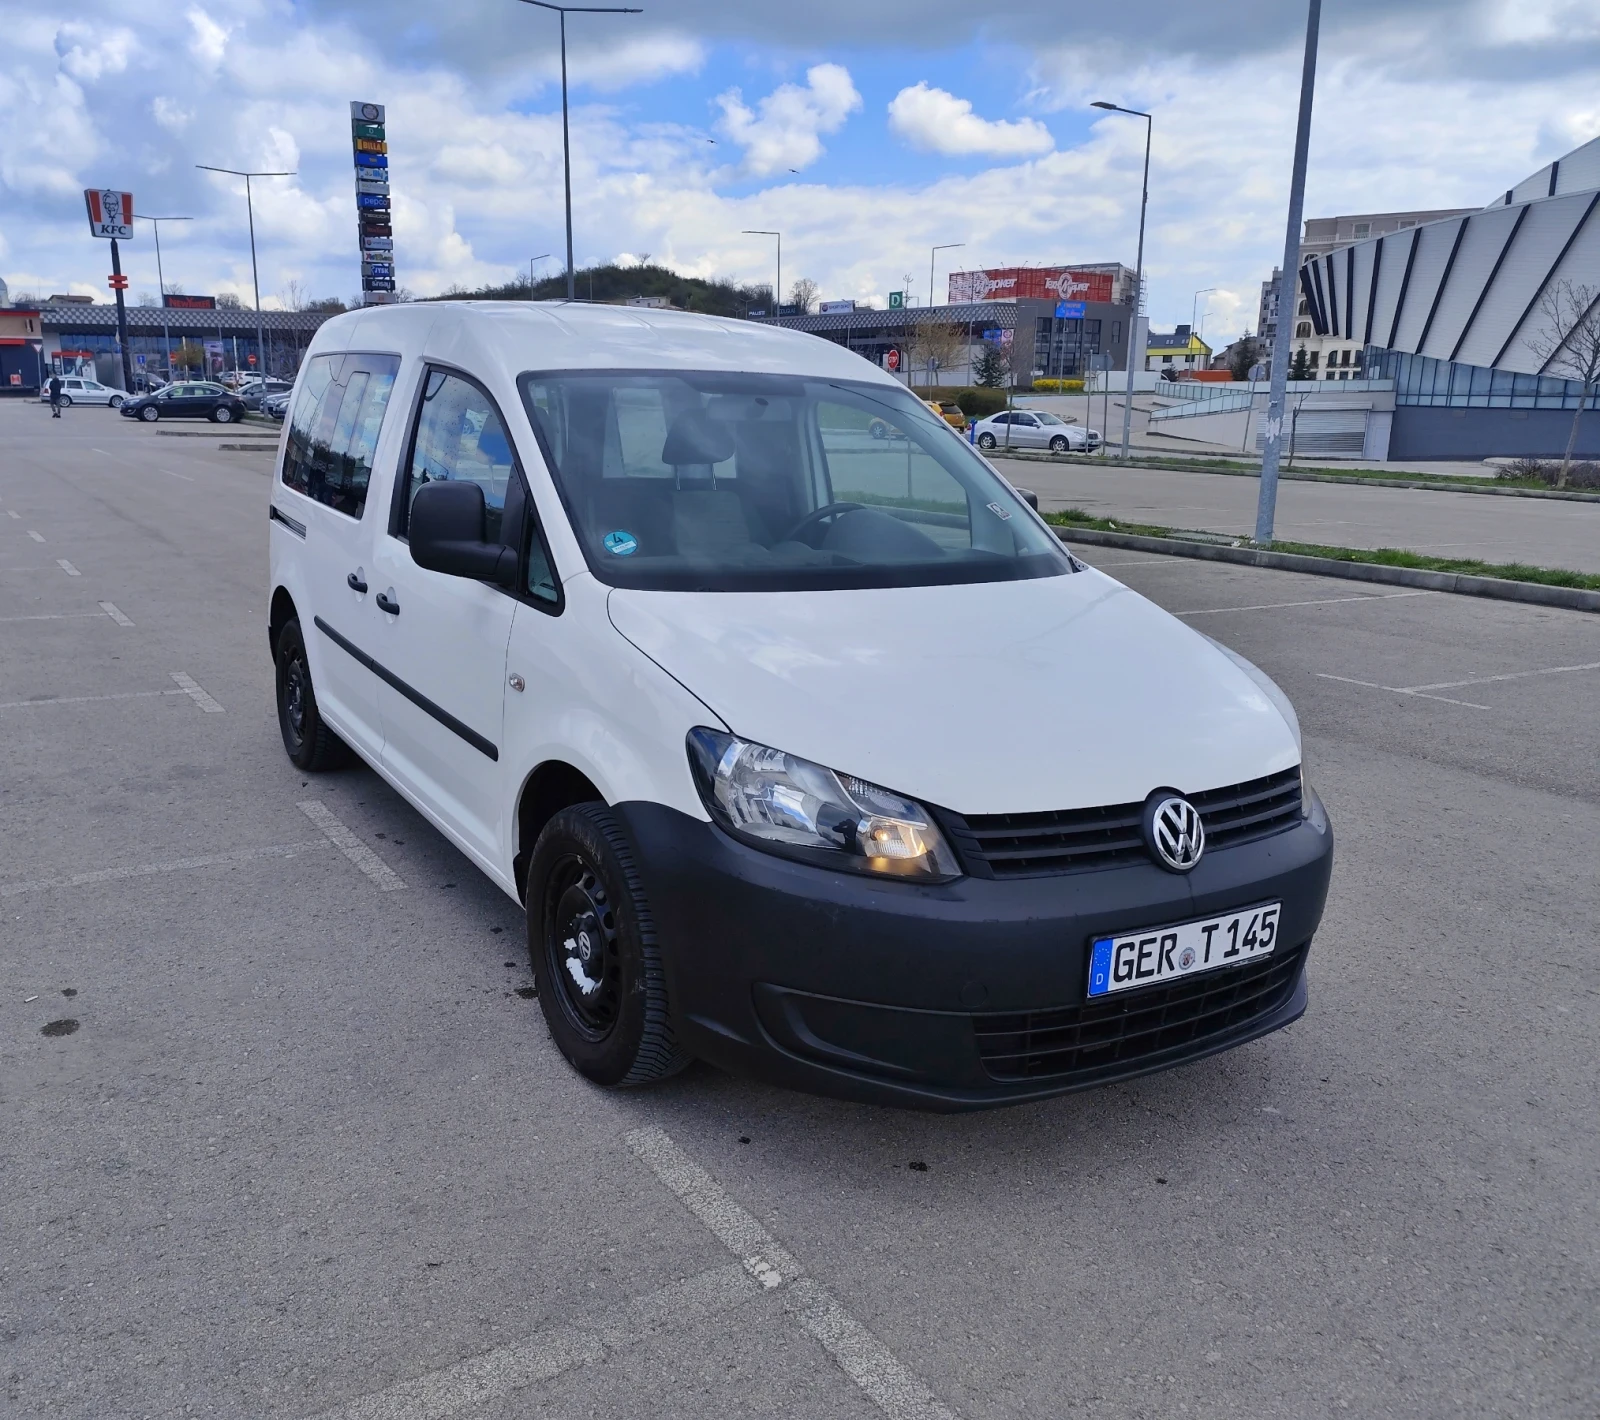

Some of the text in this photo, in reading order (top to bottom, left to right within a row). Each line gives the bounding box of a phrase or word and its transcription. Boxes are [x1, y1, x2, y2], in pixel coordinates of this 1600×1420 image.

[363, 142, 381, 151] BILLA
[364, 198, 388, 206] pepco
[100, 224, 127, 235] KFC
[891, 294, 900, 306] D
[888, 356, 898, 364] STOP
[1113, 909, 1278, 983] GER T 145
[1095, 973, 1104, 985] D
